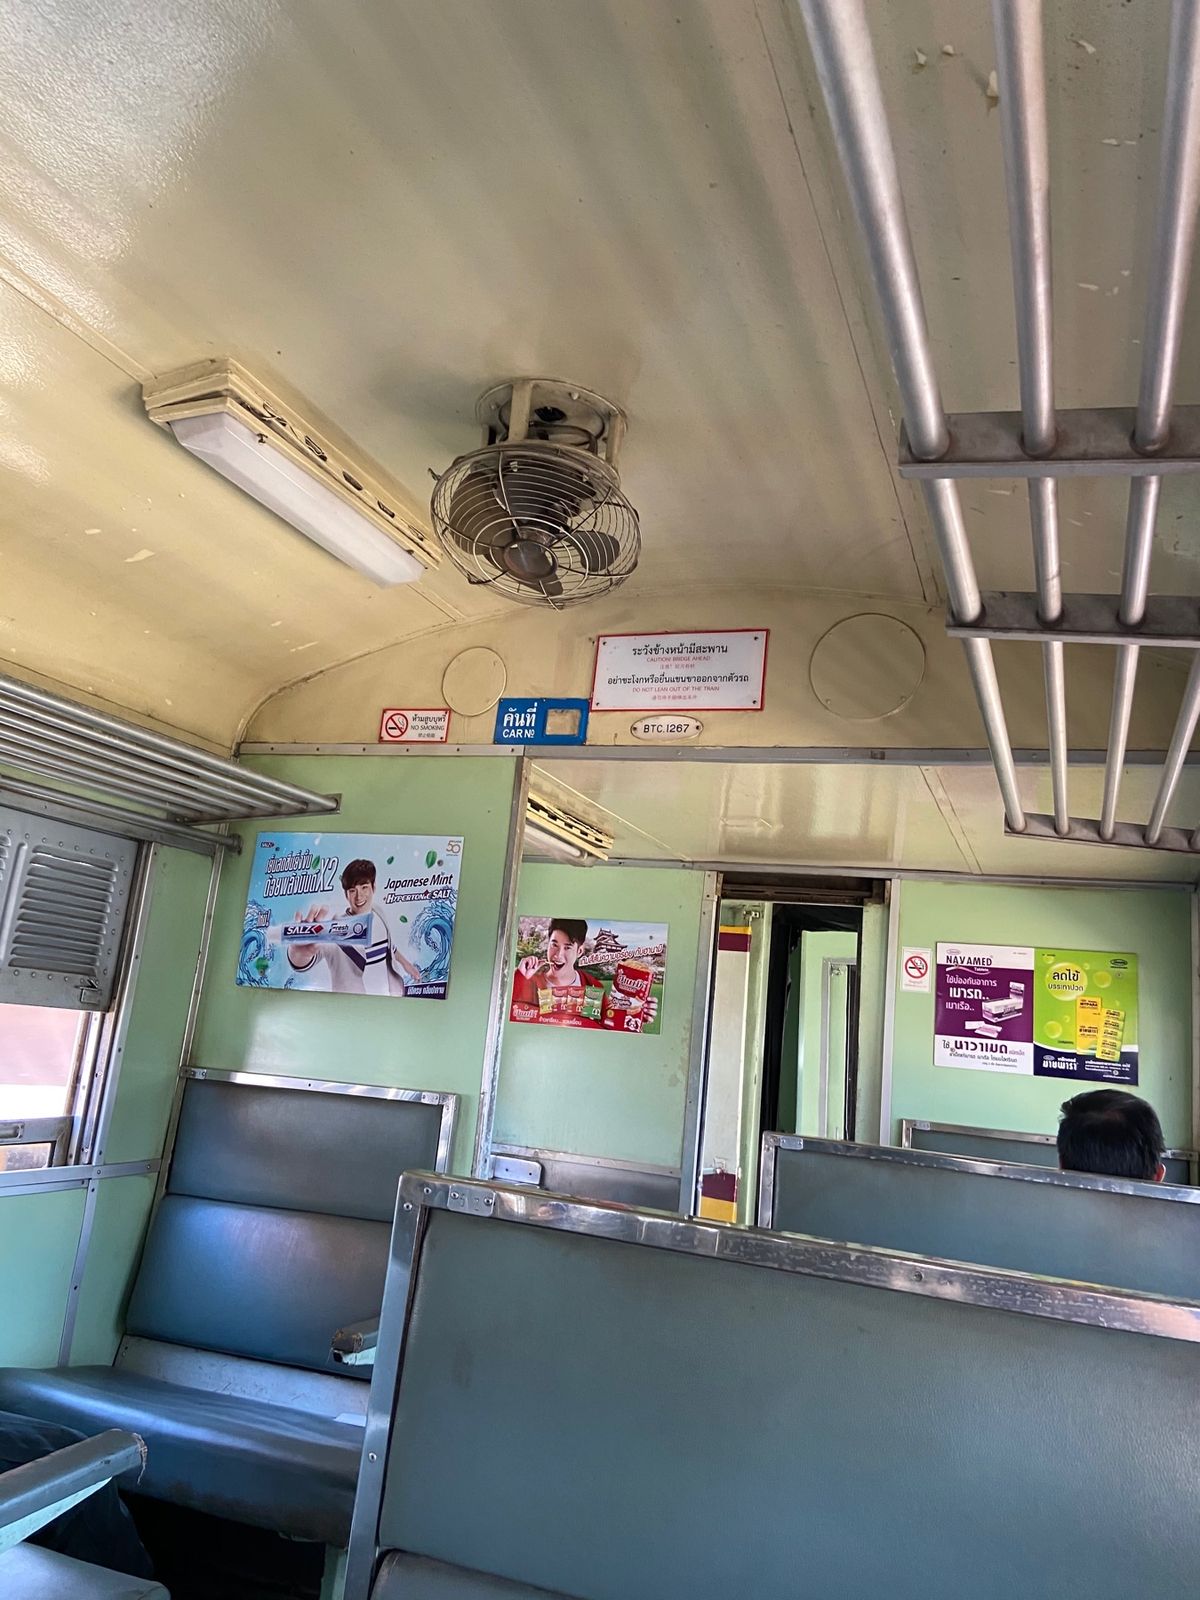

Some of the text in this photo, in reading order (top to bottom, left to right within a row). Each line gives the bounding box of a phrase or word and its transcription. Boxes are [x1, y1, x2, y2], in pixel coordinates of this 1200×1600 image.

[632, 643, 728, 656] ระวังข้างหน้ามีสะพาน
[607, 671, 749, 685] อย่าชะโงกหรือยื่นแขนขาออกจากตัวรถ
[411, 713, 447, 725] ห้ามสูบบุหรี่
[503, 702, 538, 727] คันที่
[502, 728, 523, 738] CAR
[643, 723, 690, 734] BTC.1267
[384, 873, 453, 891] Japanese Mint
[431, 889, 452, 899] SALT
[286, 925, 311, 935] SALZ
[329, 923, 349, 933] Fresh
[946, 955, 992, 966] NAVAMED
[1052, 968, 1080, 981] ลดไข้
[945, 974, 997, 987] ใช้ป้องกันอาการ
[1048, 983, 1083, 992] บรรเทาปวด
[954, 1040, 1008, 1054] นาวาเมด
[1042, 1060, 1077, 1071] มายพารา
